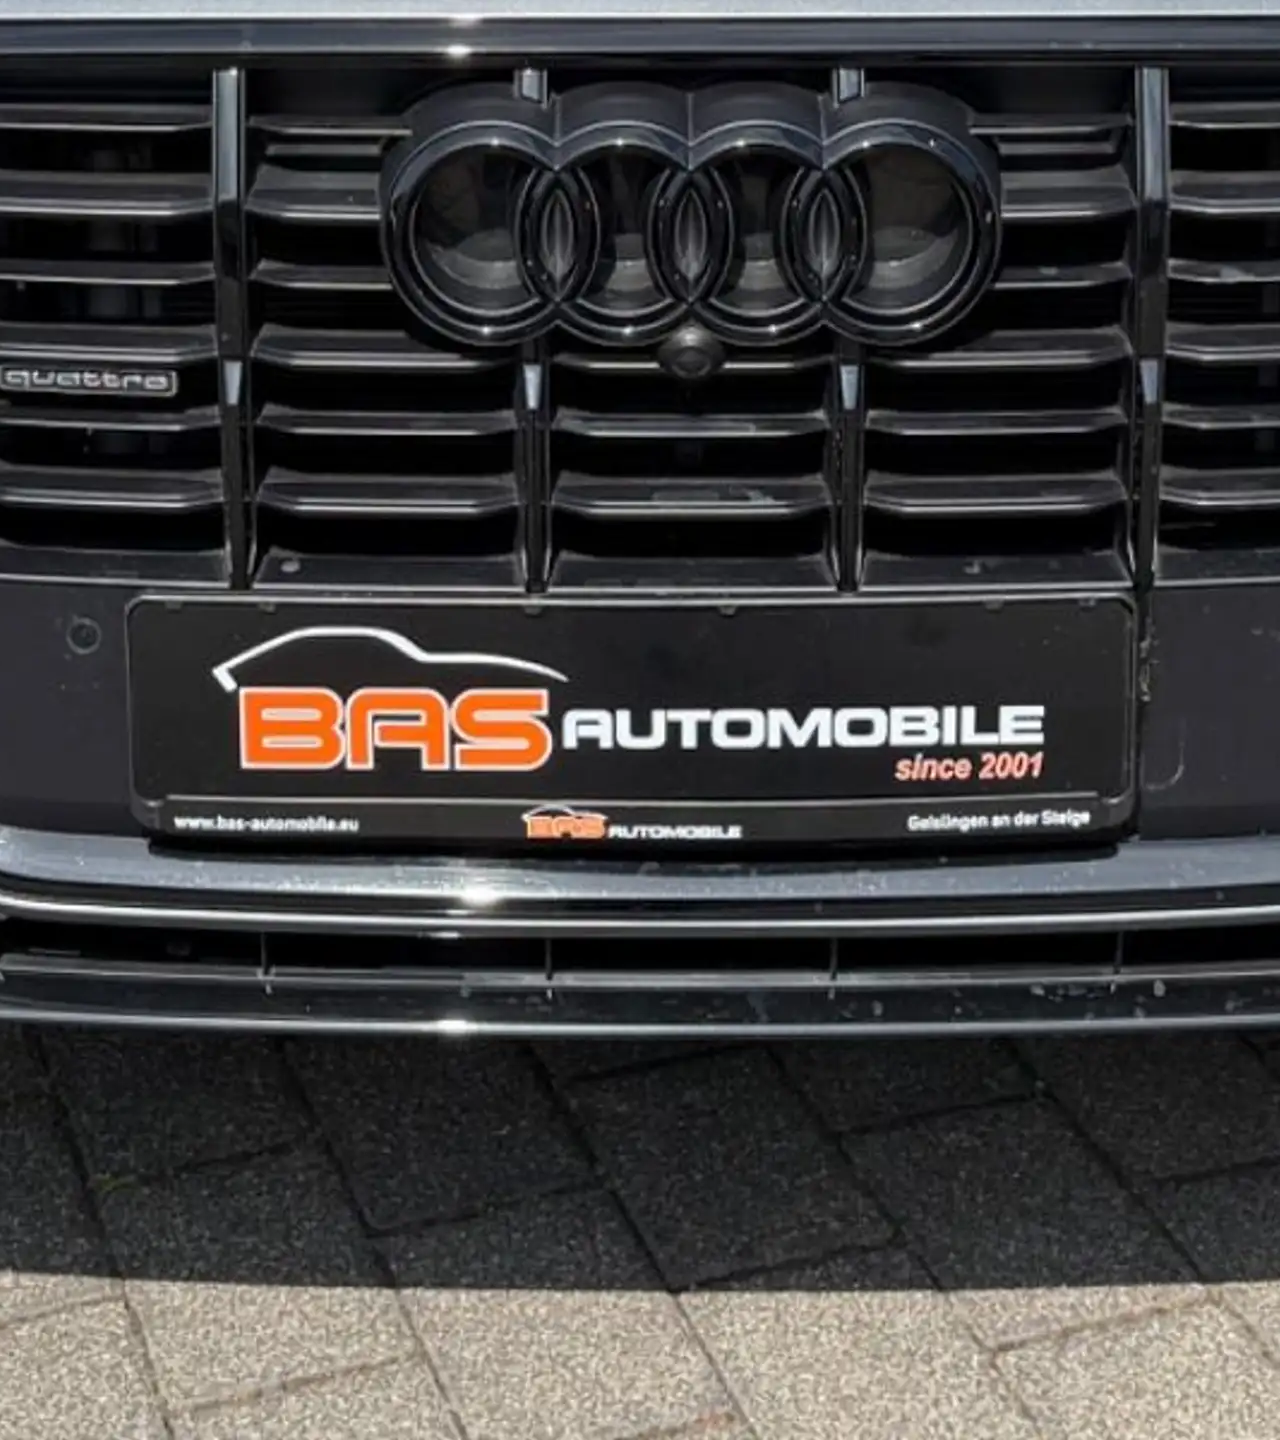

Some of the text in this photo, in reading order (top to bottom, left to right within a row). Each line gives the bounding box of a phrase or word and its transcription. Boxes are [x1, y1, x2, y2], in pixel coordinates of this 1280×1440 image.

[4, 369, 169, 393] quattro
[239, 686, 1045, 771] BAS AUTOMOBILE
[894, 750, 1045, 782] since 2001
[173, 813, 360, 833] www.bas-automobile.eu
[526, 815, 742, 840] BAS AUTOMOBILE
[907, 809, 1091, 833] Geislingen an der Steige
